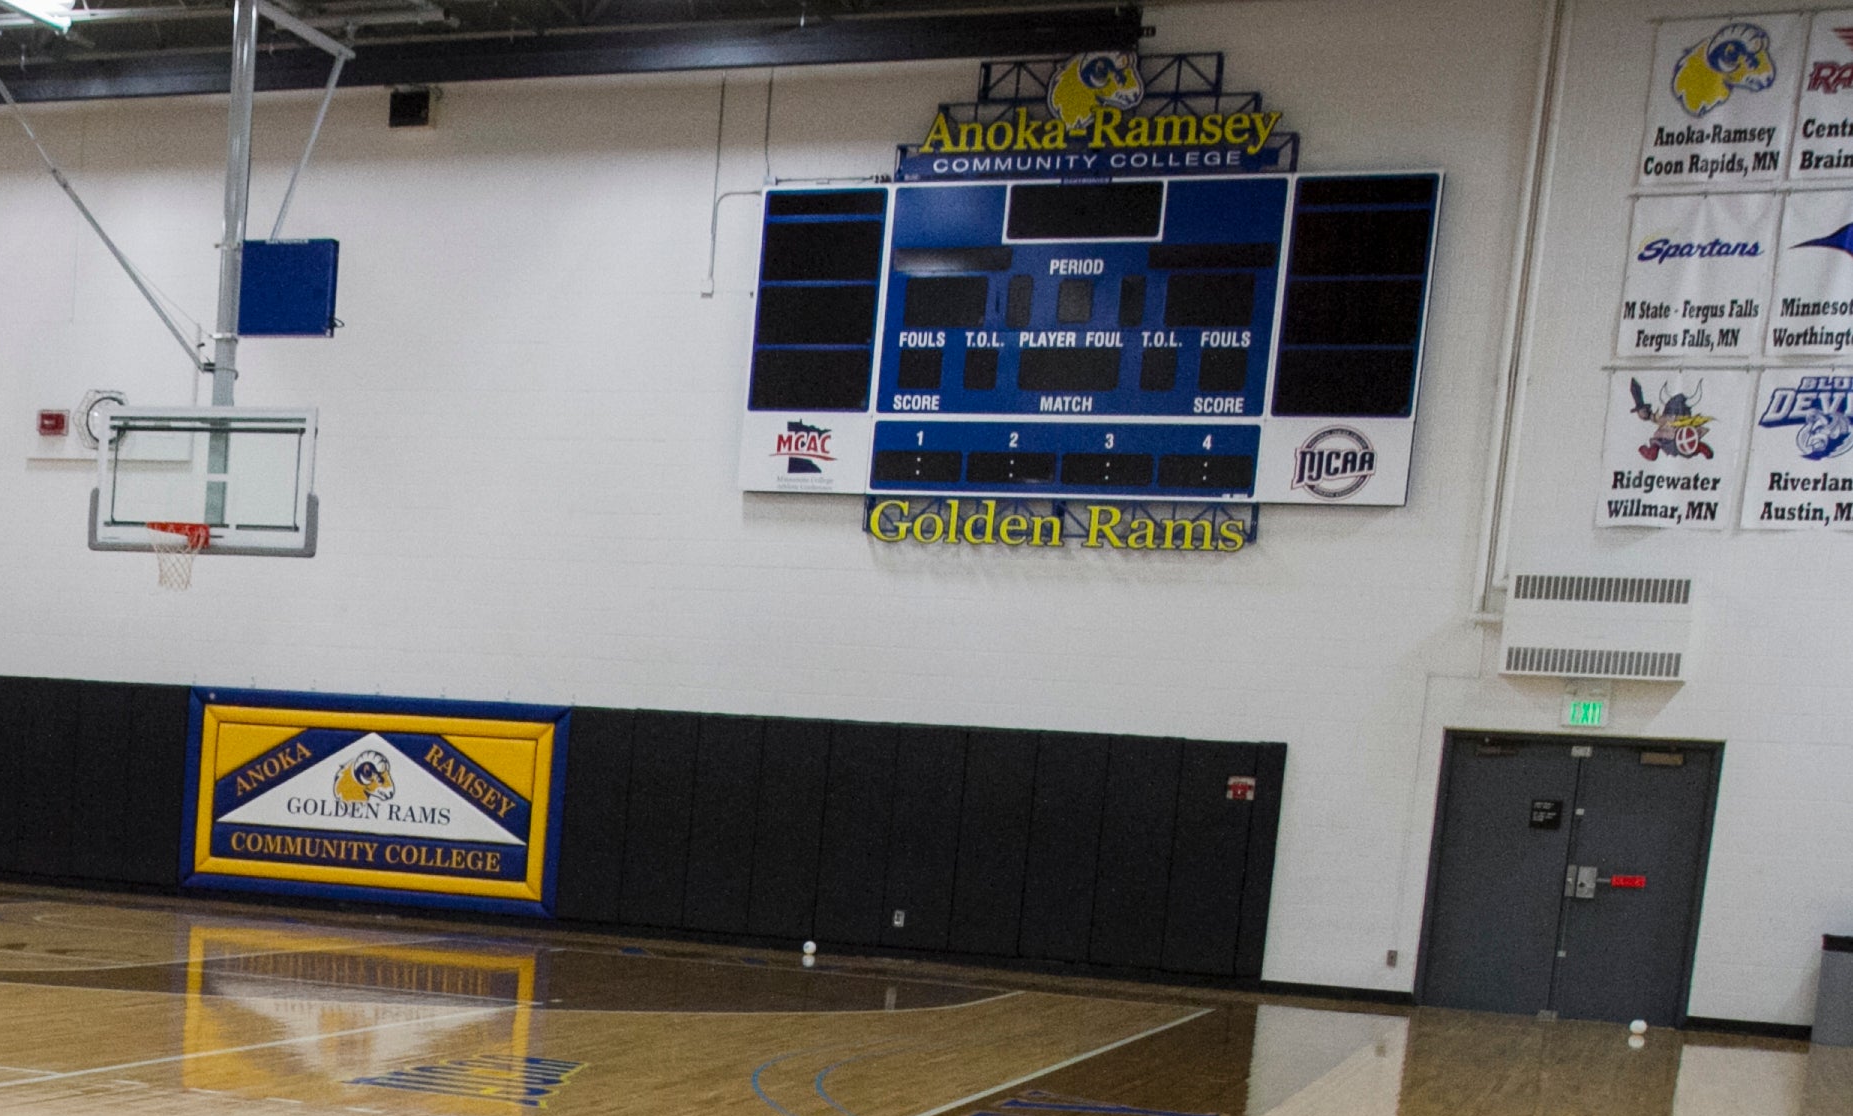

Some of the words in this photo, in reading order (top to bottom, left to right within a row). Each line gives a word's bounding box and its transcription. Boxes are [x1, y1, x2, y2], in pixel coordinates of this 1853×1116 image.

[920, 106, 1283, 155] Anoka-Ramsey
[1654, 124, 1776, 147] Anoka-Ramsey
[933, 155, 1098, 173] COMMUNITY
[1110, 151, 1242, 168] COLLEGE
[1644, 157, 1684, 175] Coon
[1688, 153, 1748, 178] Rapids,
[1752, 151, 1780, 171] MN
[1637, 238, 1764, 264] Spartans
[1049, 259, 1104, 275] PERIOD
[1623, 302, 1636, 319] M
[1639, 301, 1671, 319] State
[1682, 300, 1725, 324] Fergus
[1728, 299, 1759, 318] Falls
[899, 332, 945, 347] FOULS
[965, 332, 1005, 347] T.O.L.
[1019, 332, 1076, 347] PLAYER
[1085, 332, 1123, 347] FOUL
[1142, 332, 1183, 347] T.O.L.
[1200, 332, 1251, 347] FOULS
[1635, 329, 1678, 352] Fergus
[1681, 329, 1715, 352] Falls,
[1717, 329, 1740, 347] MN
[1773, 326, 1853, 351] Worthingt
[893, 395, 940, 411] SCORE
[1039, 396, 1093, 412] MATCH
[1193, 397, 1244, 413] SCORE
[777, 433, 831, 454] MCAC
[917, 431, 924, 446] 1
[1009, 432, 1019, 447] 2
[1105, 434, 1114, 449] 3
[1202, 435, 1212, 450] 4
[1295, 451, 1375, 484] NJCAA
[1612, 471, 1721, 493] Ridgewater
[1607, 500, 1682, 524] Willmar,
[1685, 502, 1718, 520] MN
[1760, 502, 1830, 527] Austin,
[869, 499, 1064, 546] Golden
[1082, 505, 1246, 551] Rams
[1570, 702, 1603, 726] EXIT
[234, 742, 313, 797] ANOKA
[423, 743, 516, 819] RAMSEY
[286, 797, 380, 819] GOLDEN
[386, 803, 451, 826] RAMS
[230, 831, 379, 863] COMMUNITY
[384, 843, 501, 873] COLLEGE
